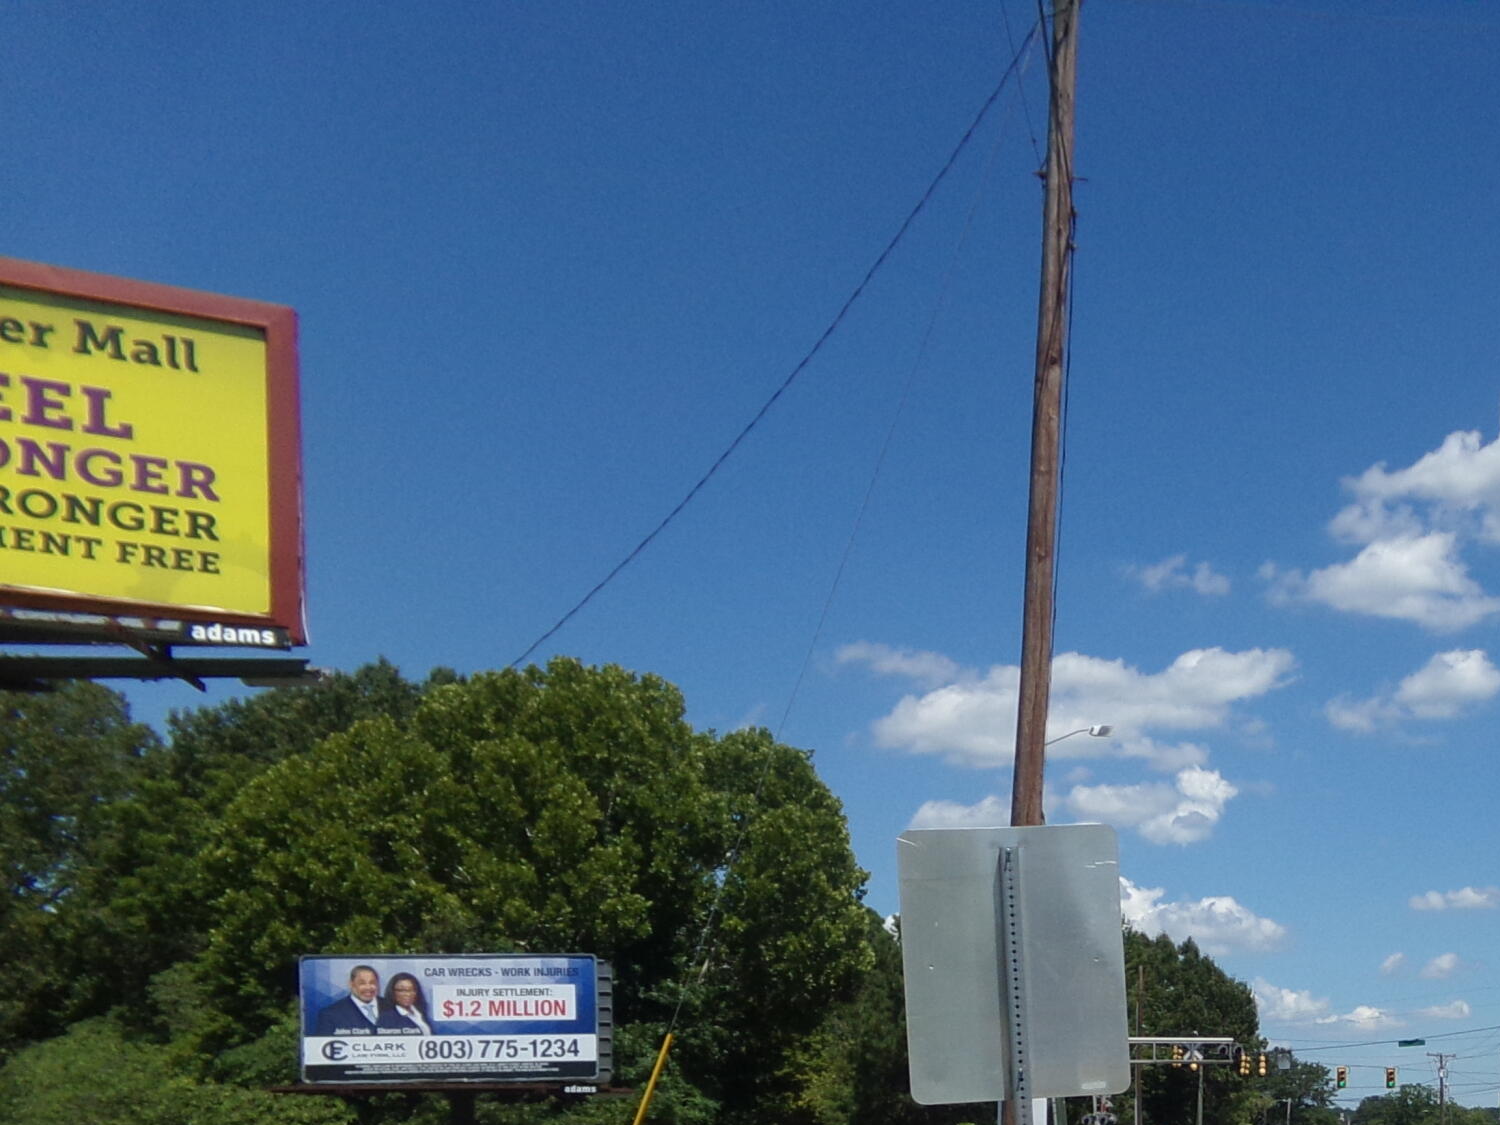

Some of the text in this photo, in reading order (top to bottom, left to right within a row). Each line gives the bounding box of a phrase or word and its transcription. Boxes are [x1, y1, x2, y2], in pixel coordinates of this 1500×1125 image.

[72, 318, 199, 373] Mall
[0, 370, 133, 440] EL
[0, 437, 220, 503] NGER
[0, 526, 221, 575] ENT FREE
[191, 623, 276, 645] adams
[424, 967, 446, 977] CAR
[448, 967, 492, 977] WRECKS
[501, 967, 531, 977] WORK
[533, 967, 579, 977] INJURIES
[456, 987, 553, 997] INJURY SETTLEMENT:
[443, 999, 567, 1019] $1.2 MILLION
[352, 1042, 407, 1052] CLARK
[418, 1038, 580, 1060] (803) 775-1234
[564, 1084, 597, 1093] adams
